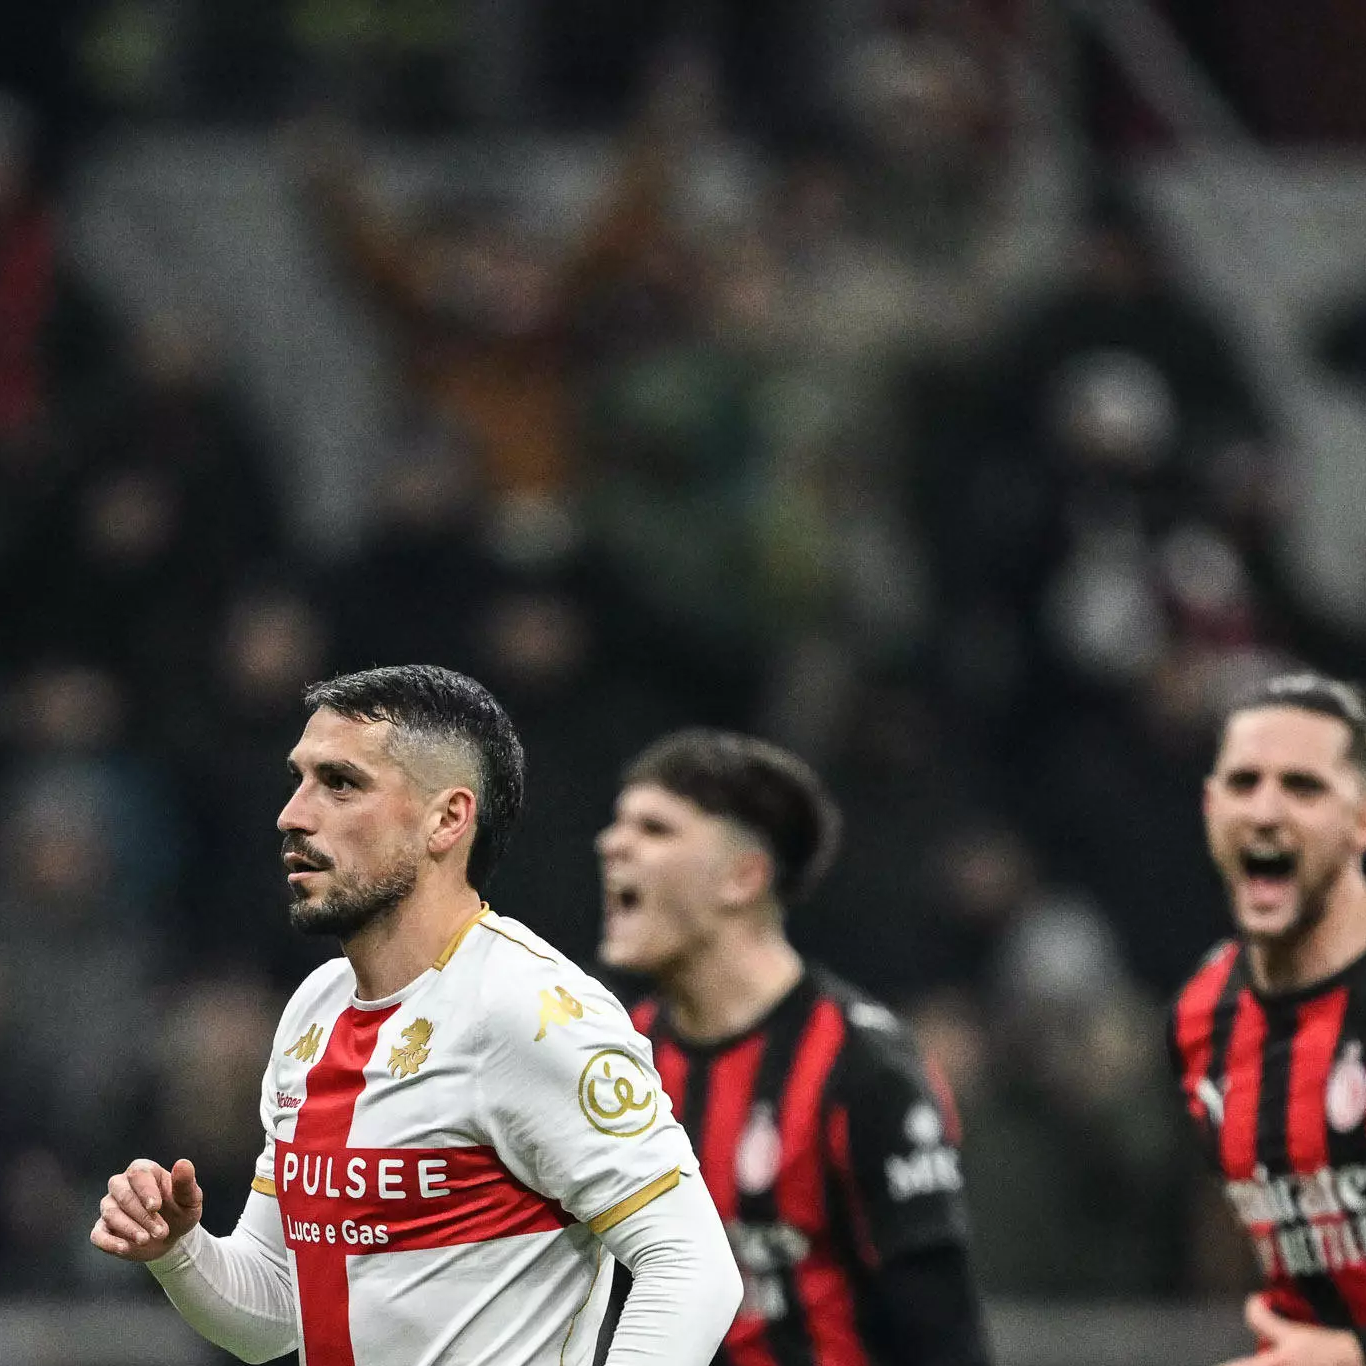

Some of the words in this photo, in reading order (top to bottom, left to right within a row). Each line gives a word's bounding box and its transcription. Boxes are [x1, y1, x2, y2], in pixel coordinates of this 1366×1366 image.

[283, 1152, 451, 1199] PULSEE
[287, 1214, 321, 1243] Luce
[325, 1223, 335, 1244] e
[341, 1219, 389, 1245] Gas
